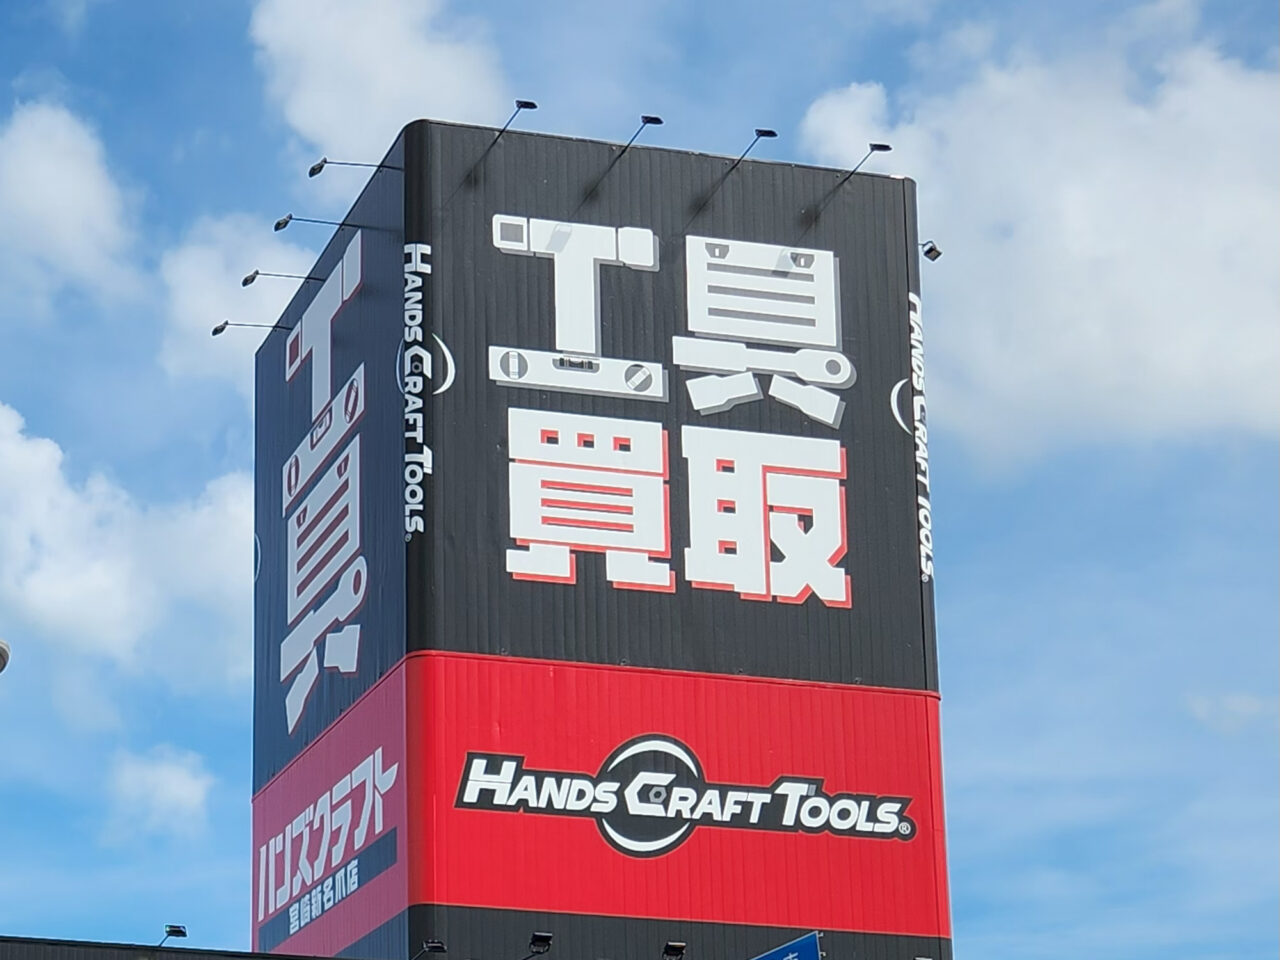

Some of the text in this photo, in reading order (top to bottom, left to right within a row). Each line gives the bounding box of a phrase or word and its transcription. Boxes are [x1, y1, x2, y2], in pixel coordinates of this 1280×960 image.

[404, 243, 431, 342] HANDS
[489, 213, 857, 428] 工具
[404, 345, 432, 443] CRAFT
[505, 407, 852, 608] 買取
[257, 745, 399, 923] ハンズクラフト
[463, 758, 620, 813] HANDS
[624, 771, 771, 825] CRAFT
[288, 857, 359, 936] 宮崎新名爪店
